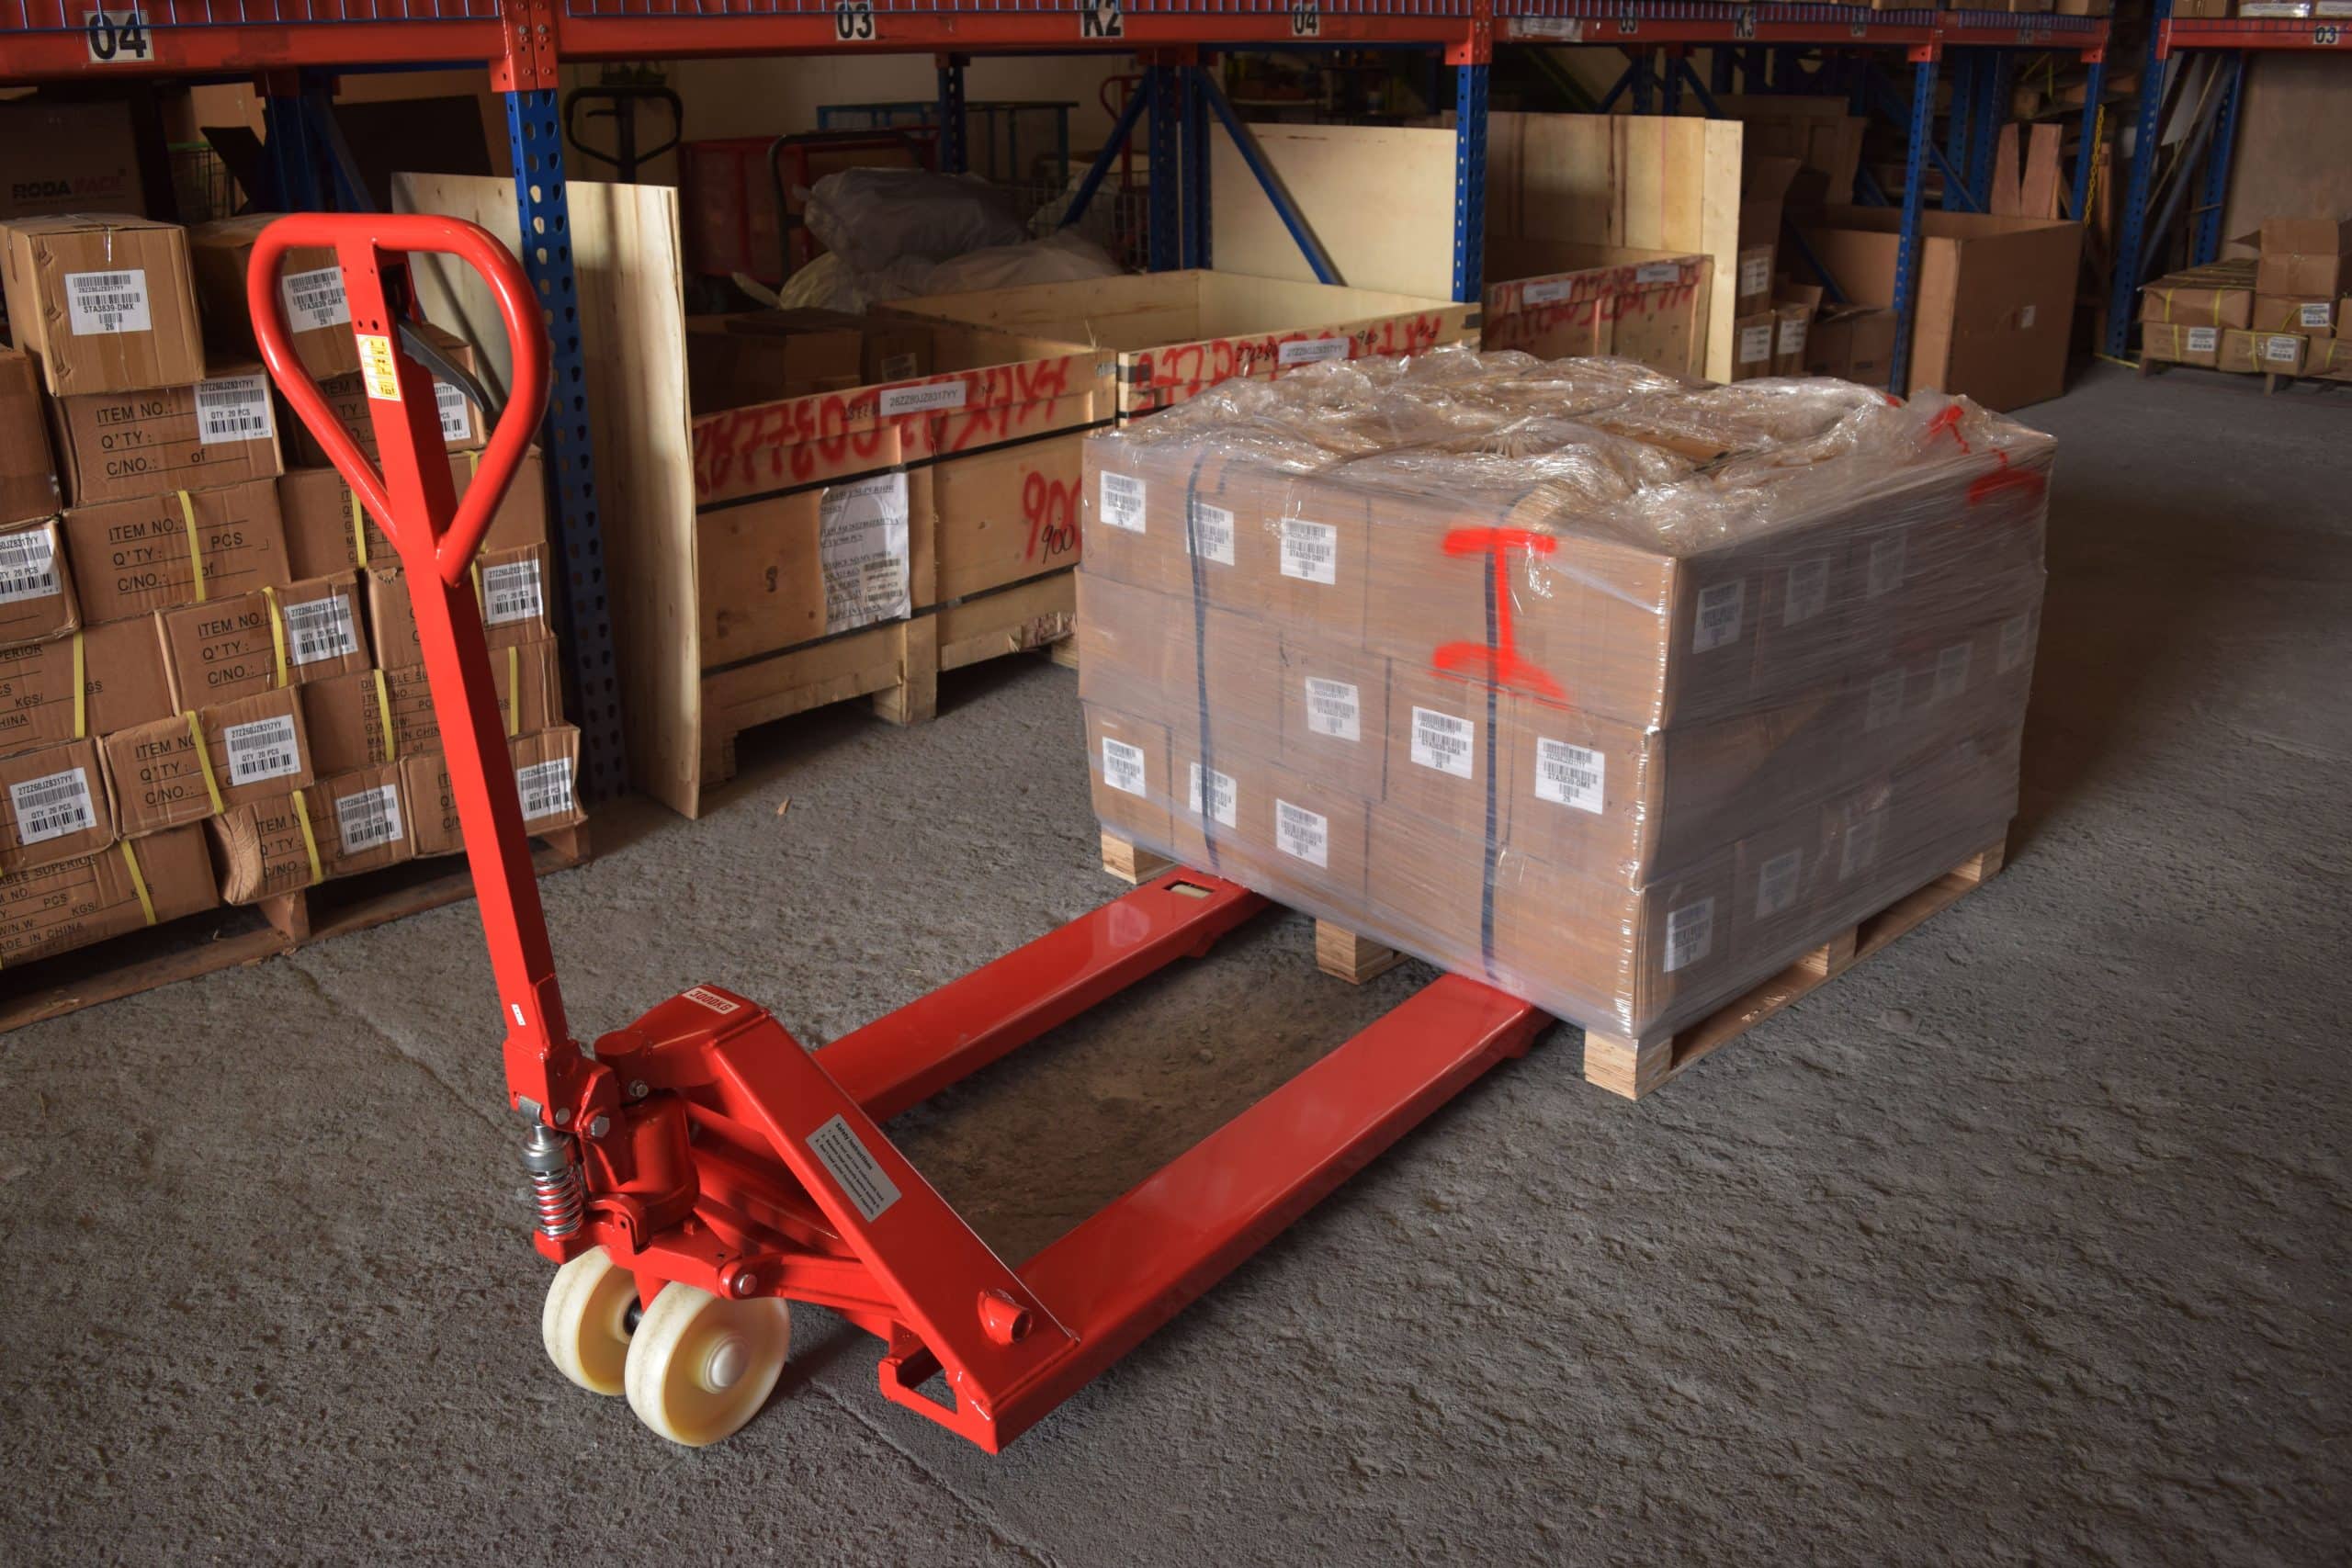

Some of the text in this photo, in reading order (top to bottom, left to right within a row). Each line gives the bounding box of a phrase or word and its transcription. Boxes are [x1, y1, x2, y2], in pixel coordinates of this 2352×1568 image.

[837, 3, 872, 39] 03
[1084, 0, 1120, 37] K2
[1294, 5, 1317, 35] 04
[87, 13, 147, 60] 04
[2314, 27, 2336, 44] 03
[83, 303, 134, 313] STA3839-DMX
[96, 406, 135, 423] ITEM
[210, 412, 224, 420] QTY
[237, 408, 251, 417] PCS
[190, 448, 206, 463] of
[108, 523, 146, 541] ITEM
[210, 532, 243, 549] PCS
[1042, 524, 1075, 564] 900
[24, 566, 39, 576] PCS
[198, 620, 232, 637] ITEM
[301, 632, 313, 641] QTY
[0, 714, 28, 728] HINA
[135, 739, 172, 759] ITEM
[242, 754, 254, 762] QTY
[267, 748, 279, 757] PCS
[31, 803, 73, 819] QTY 20 PCS
[43, 893, 68, 908] PCS
[29, 932, 41, 943] IN
[47, 922, 84, 938] CHINA
[689, 990, 734, 1011] 3000KG
[835, 1122, 849, 1141] Safety
